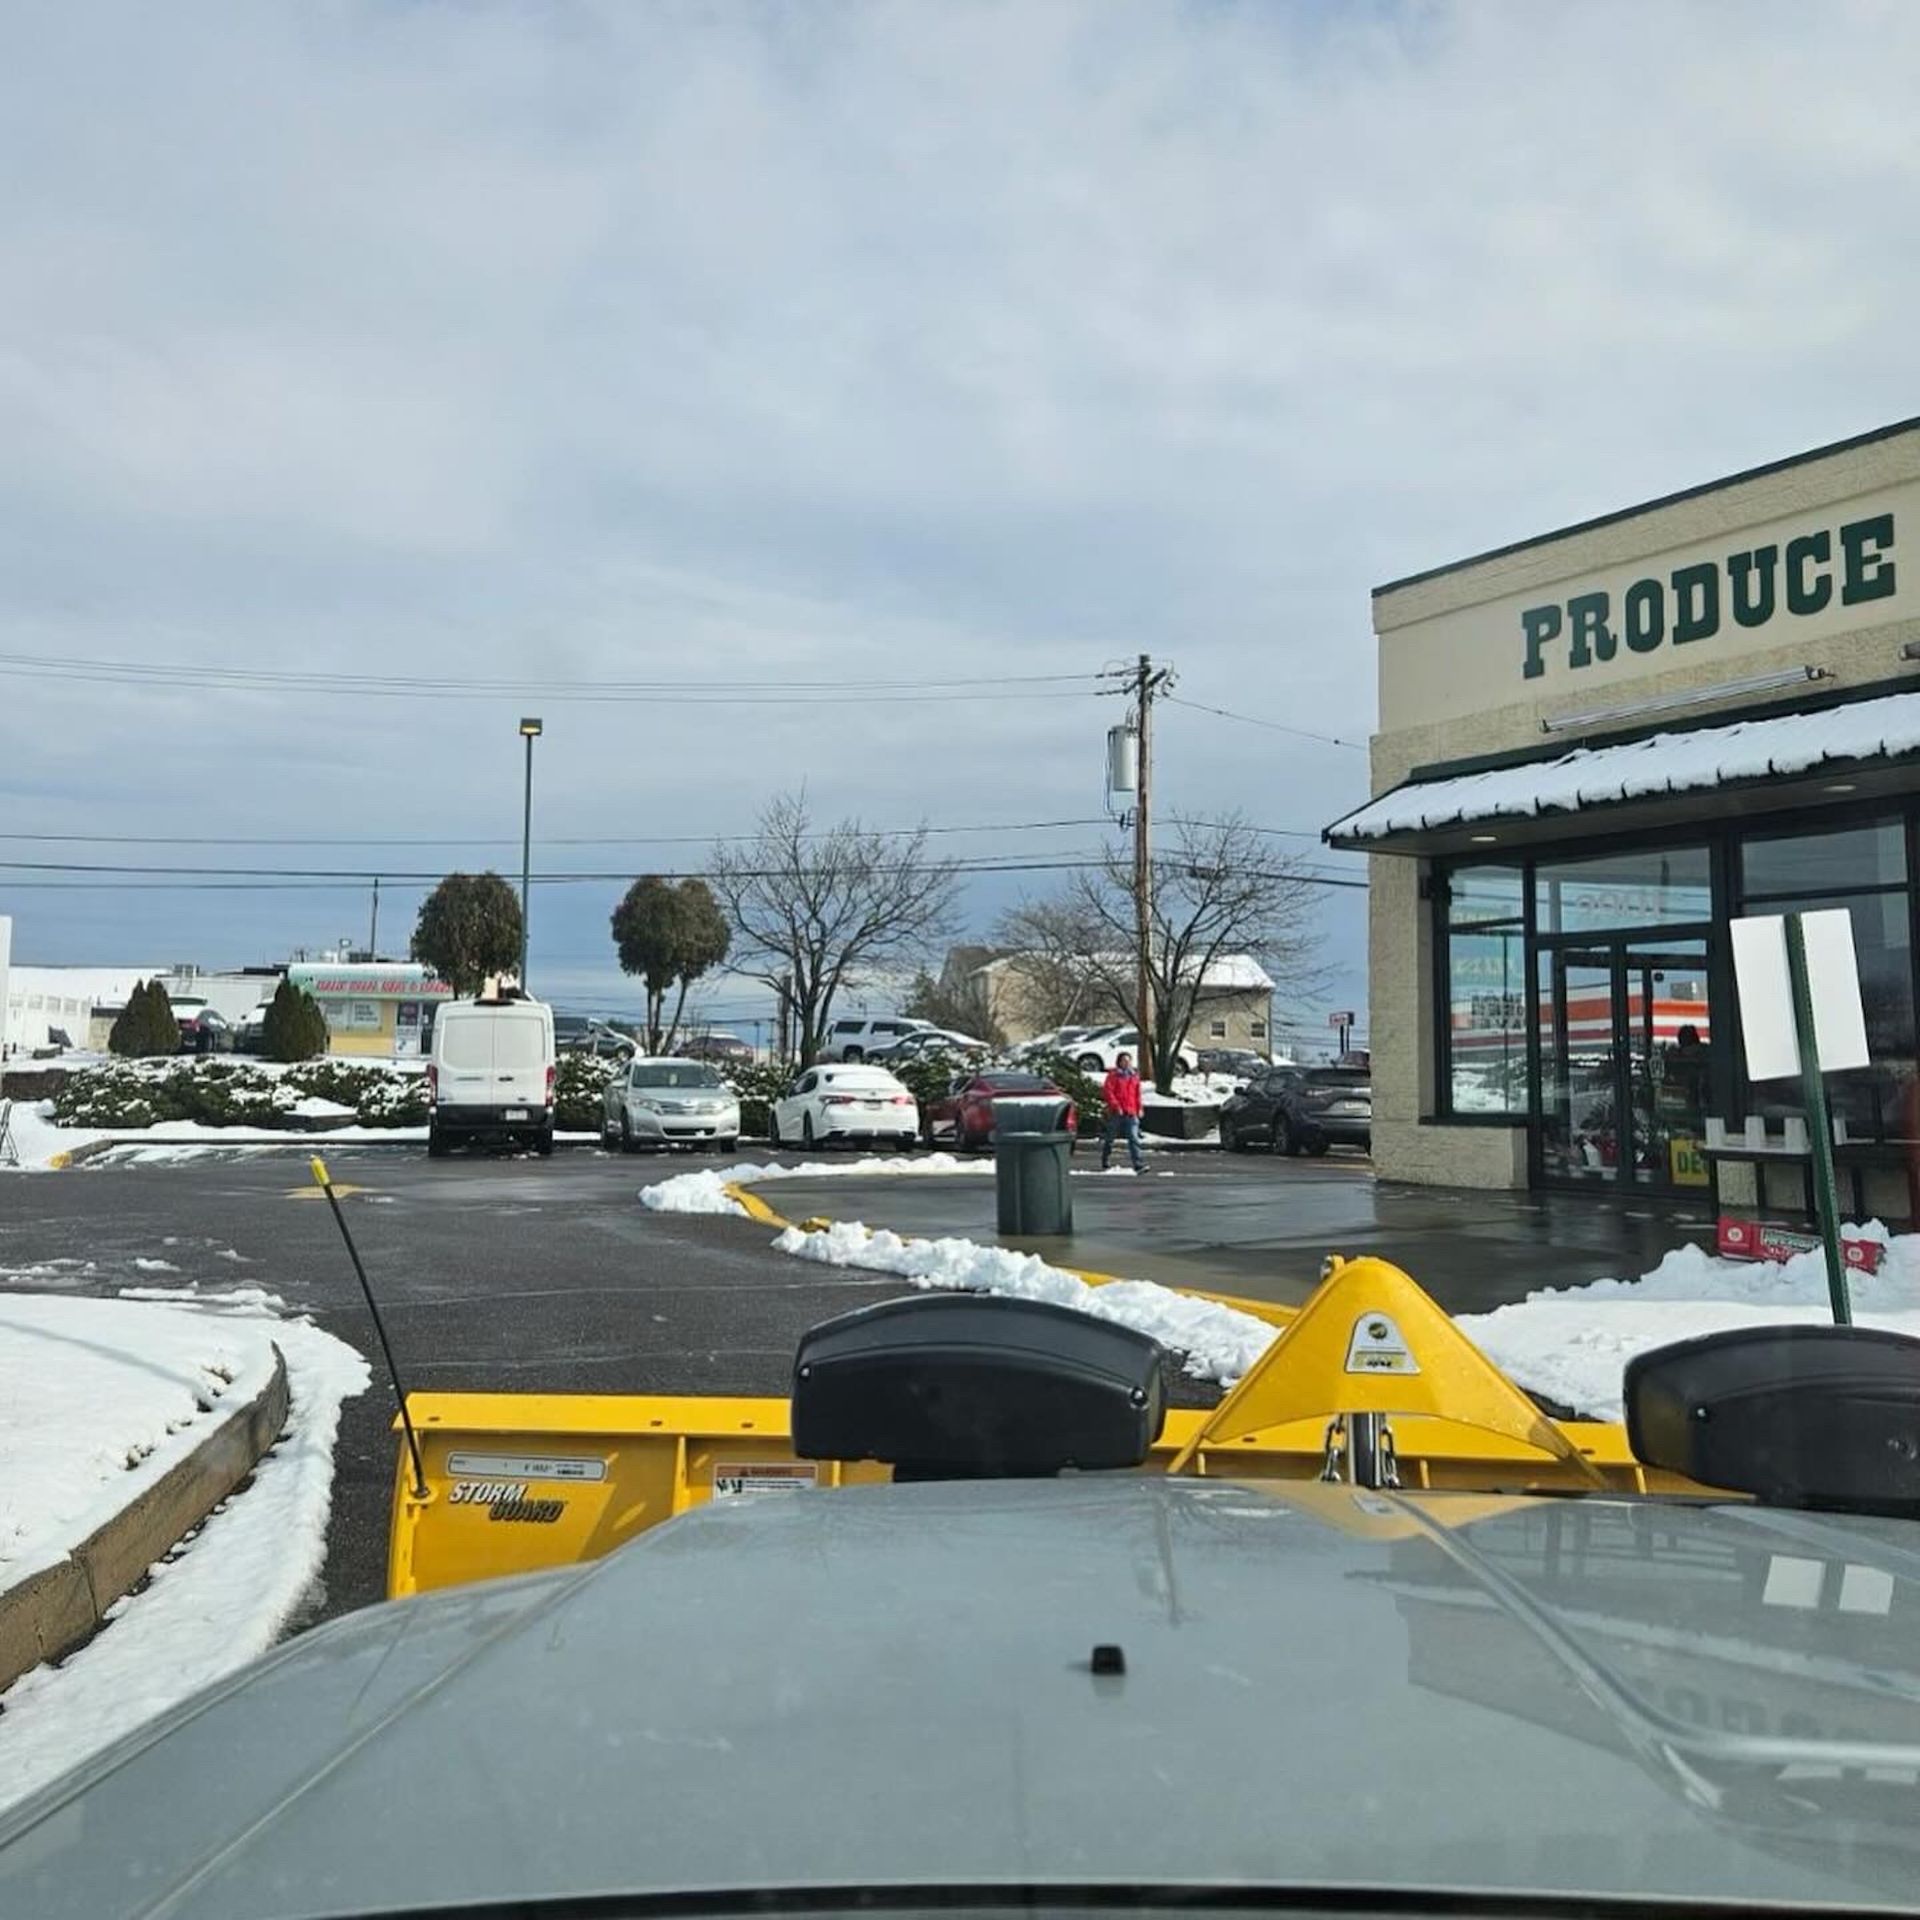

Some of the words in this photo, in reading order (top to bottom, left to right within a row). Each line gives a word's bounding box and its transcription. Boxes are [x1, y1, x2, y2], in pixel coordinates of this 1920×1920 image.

[1522, 513, 1896, 680] PRODUCE
[1677, 1151, 1708, 1175] DE
[449, 1481, 528, 1504] STORM
[489, 1499, 565, 1522] GUARD
